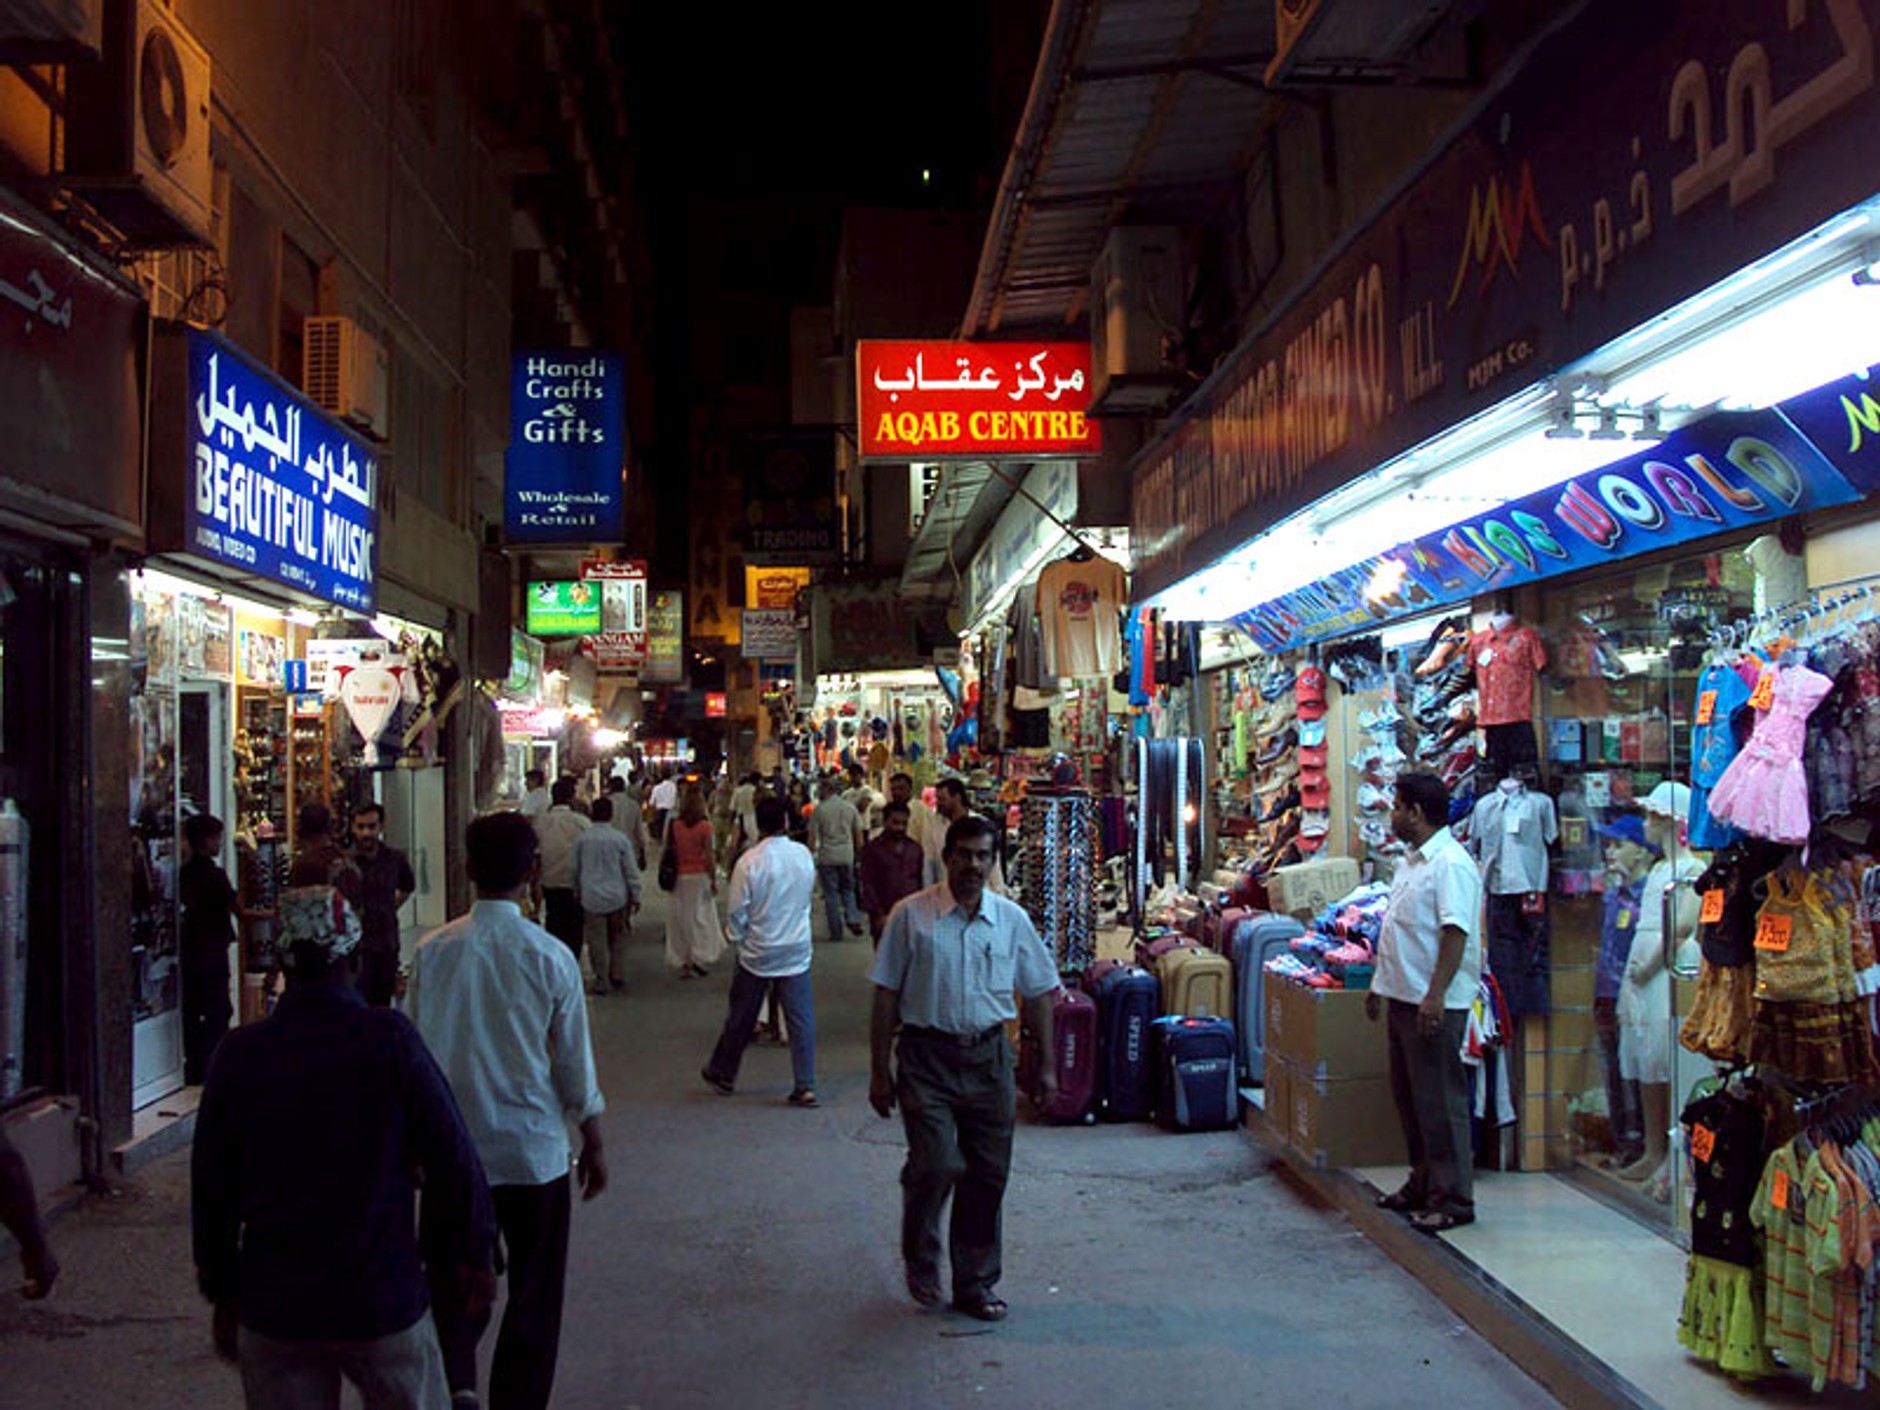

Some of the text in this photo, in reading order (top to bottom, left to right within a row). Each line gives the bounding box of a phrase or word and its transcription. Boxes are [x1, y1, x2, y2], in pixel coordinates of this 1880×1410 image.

[526, 357, 605, 378] Handi
[873, 350, 1085, 403] مركز عقاب
[526, 379, 604, 400] Crafts
[196, 352, 378, 511] الطرب الجميل
[523, 420, 605, 444] Gifts
[874, 410, 1090, 445] AQAB CENTRE
[517, 490, 611, 505] Wholesale
[1440, 435, 1804, 583] KIDS WORLD
[195, 442, 377, 585] BEAUTIFUL MUSIC
[521, 513, 597, 526] Retail
